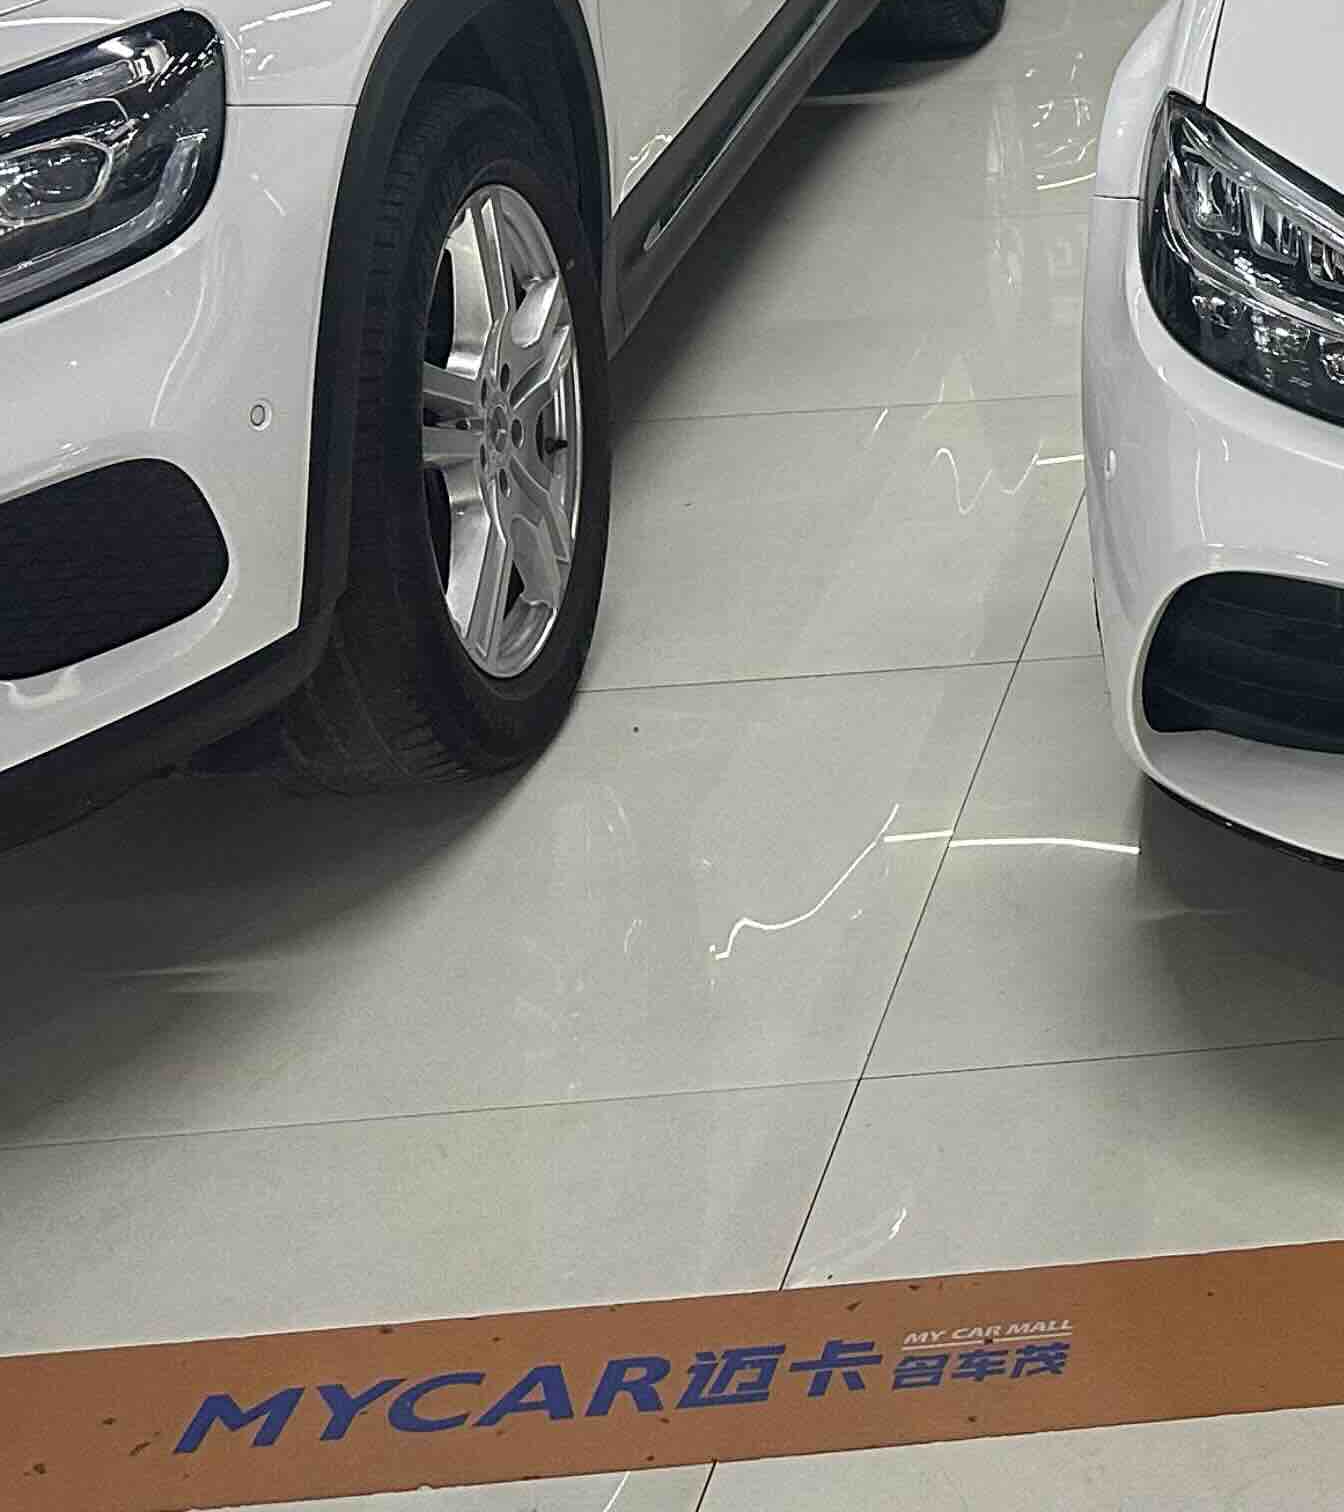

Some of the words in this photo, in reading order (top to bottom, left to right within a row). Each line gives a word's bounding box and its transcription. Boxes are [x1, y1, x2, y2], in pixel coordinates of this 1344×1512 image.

[902, 1329, 947, 1345] MY
[951, 1324, 1002, 1339] CAR
[1005, 1319, 1073, 1336] MALL
[889, 1342, 1071, 1390] 名车茂
